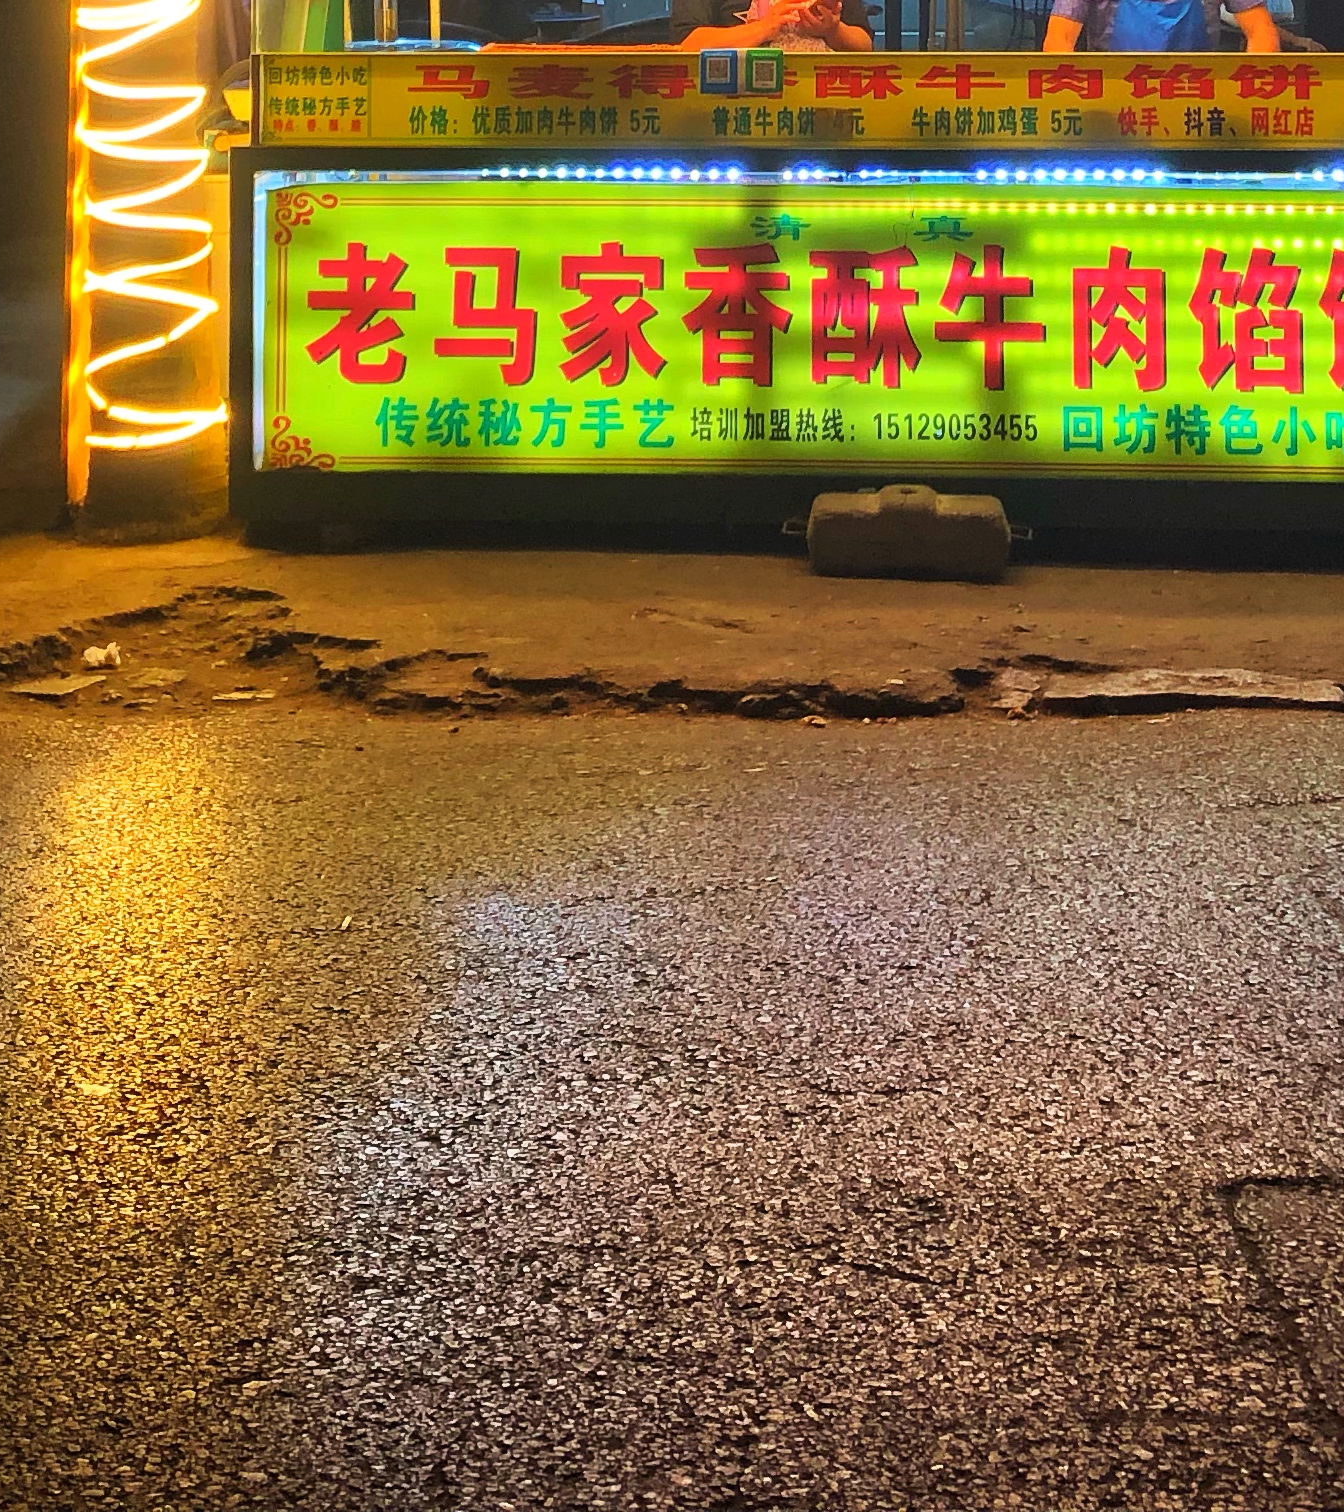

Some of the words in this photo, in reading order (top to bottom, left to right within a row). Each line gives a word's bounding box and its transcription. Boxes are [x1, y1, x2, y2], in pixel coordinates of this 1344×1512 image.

[268, 65, 367, 87] 回坊特色小吃
[407, 63, 1323, 101] 马麦得酥牛肉馅饼
[268, 96, 367, 117] 传统秘方手艺
[472, 105, 618, 136] 优质加肉牛肉饼
[712, 105, 815, 136] 普通牛肉饼
[911, 105, 1038, 136] 牛肉饼加鸡蛋
[749, 213, 810, 242] 清
[914, 215, 974, 243] 真
[375, 397, 675, 449] 传统秘方手艺
[873, 411, 1038, 443] 15129053455
